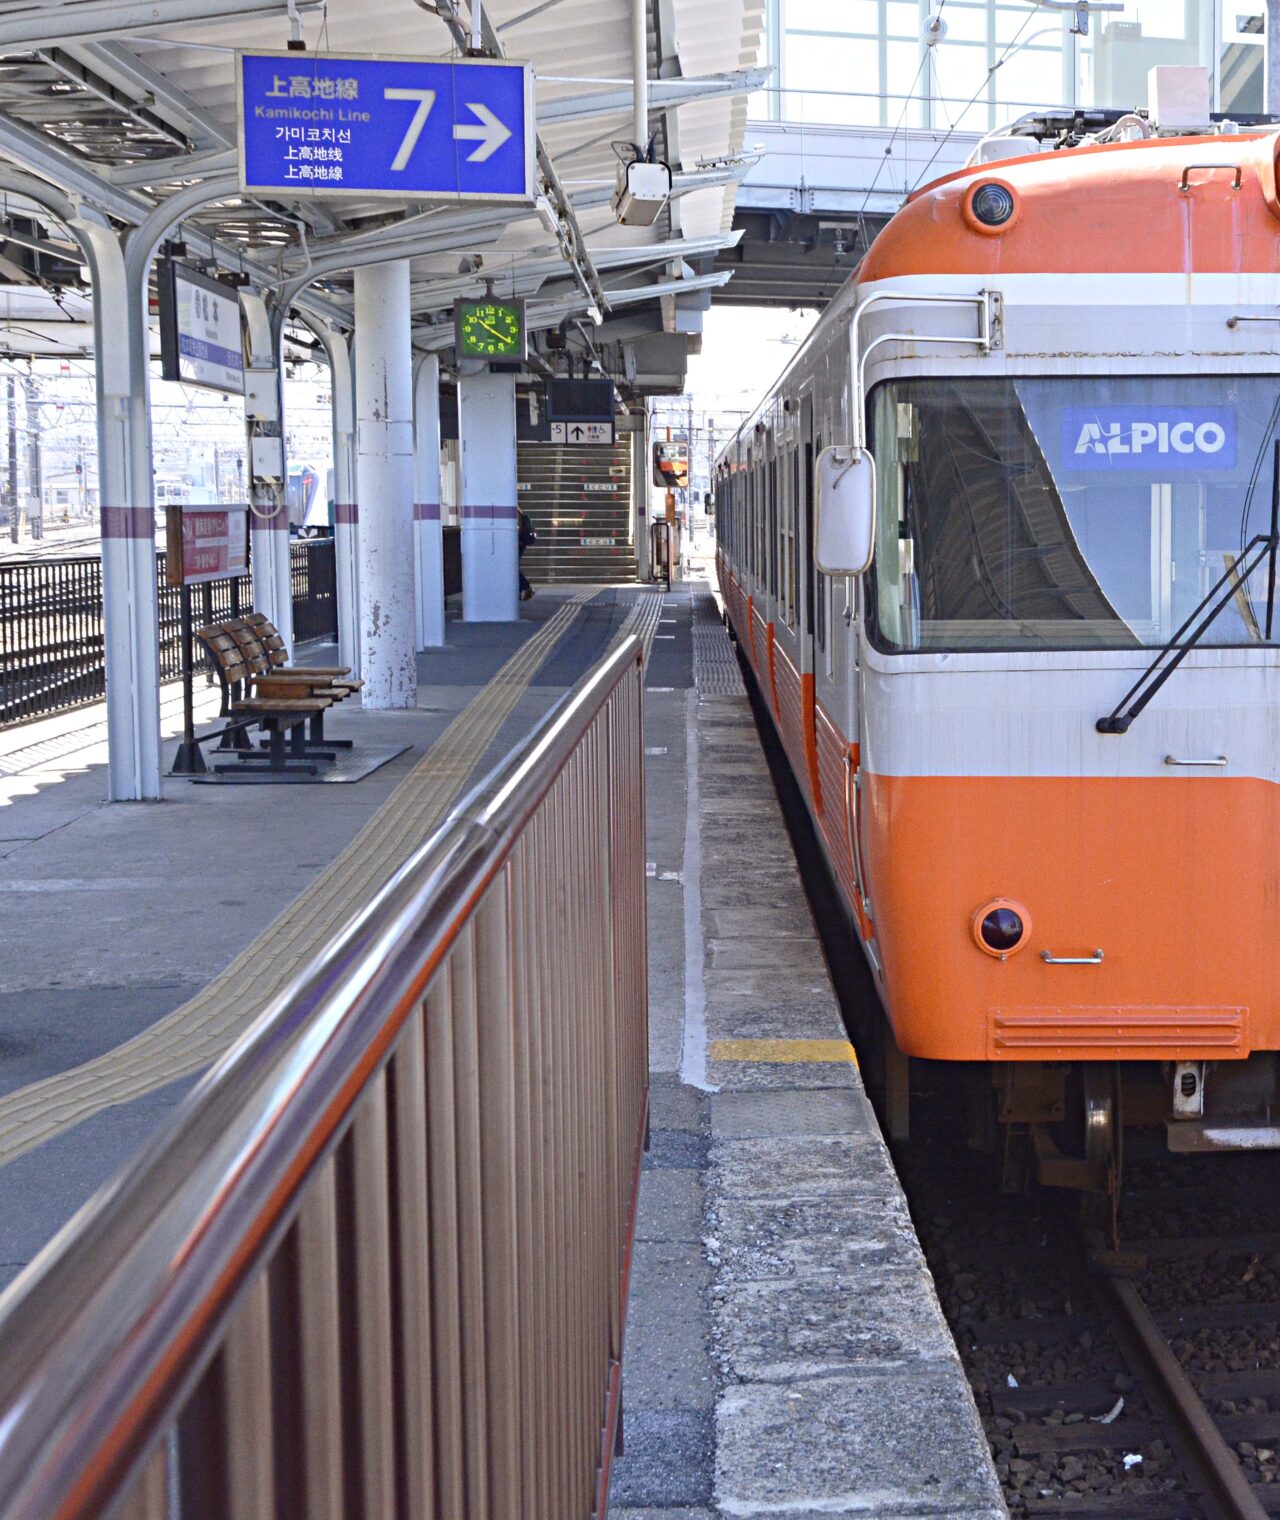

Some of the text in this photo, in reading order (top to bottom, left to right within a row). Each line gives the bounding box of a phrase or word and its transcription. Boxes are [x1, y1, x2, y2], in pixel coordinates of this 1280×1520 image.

[265, 74, 359, 100] 上高地線
[255, 105, 370, 122] Kamikochi Line
[275, 127, 351, 144] 가미코치선
[384, 87, 436, 171] 7
[284, 145, 343, 162] 上高地线
[284, 164, 343, 181] 上高地線
[1074, 421, 1226, 455] ALPICO
